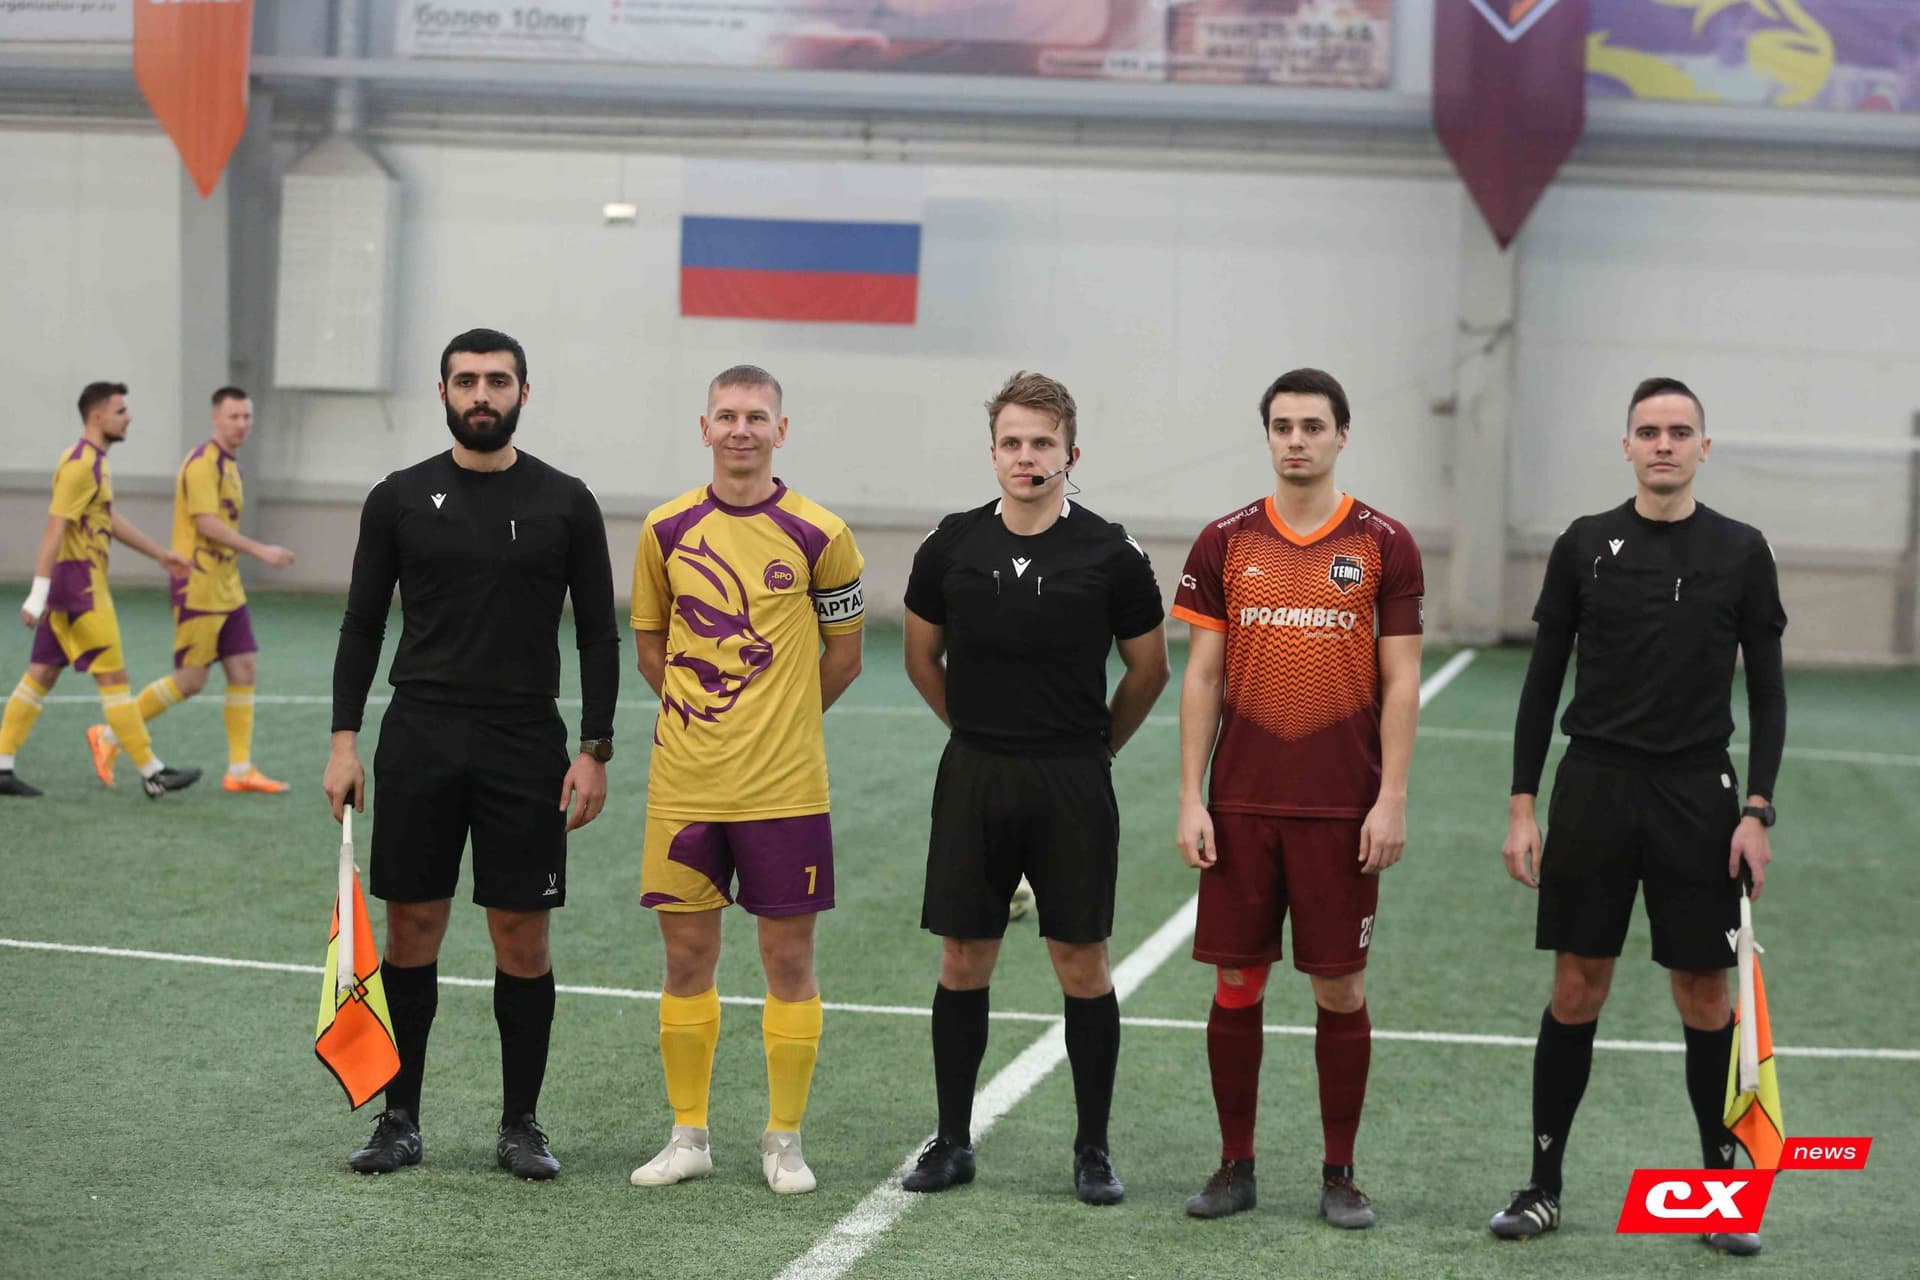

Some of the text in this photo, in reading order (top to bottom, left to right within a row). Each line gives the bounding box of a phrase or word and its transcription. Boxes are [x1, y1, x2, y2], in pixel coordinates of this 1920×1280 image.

[415, 4, 500, 29] более
[1333, 565, 1360, 582] ТЕМП
[805, 866, 817, 894] 7
